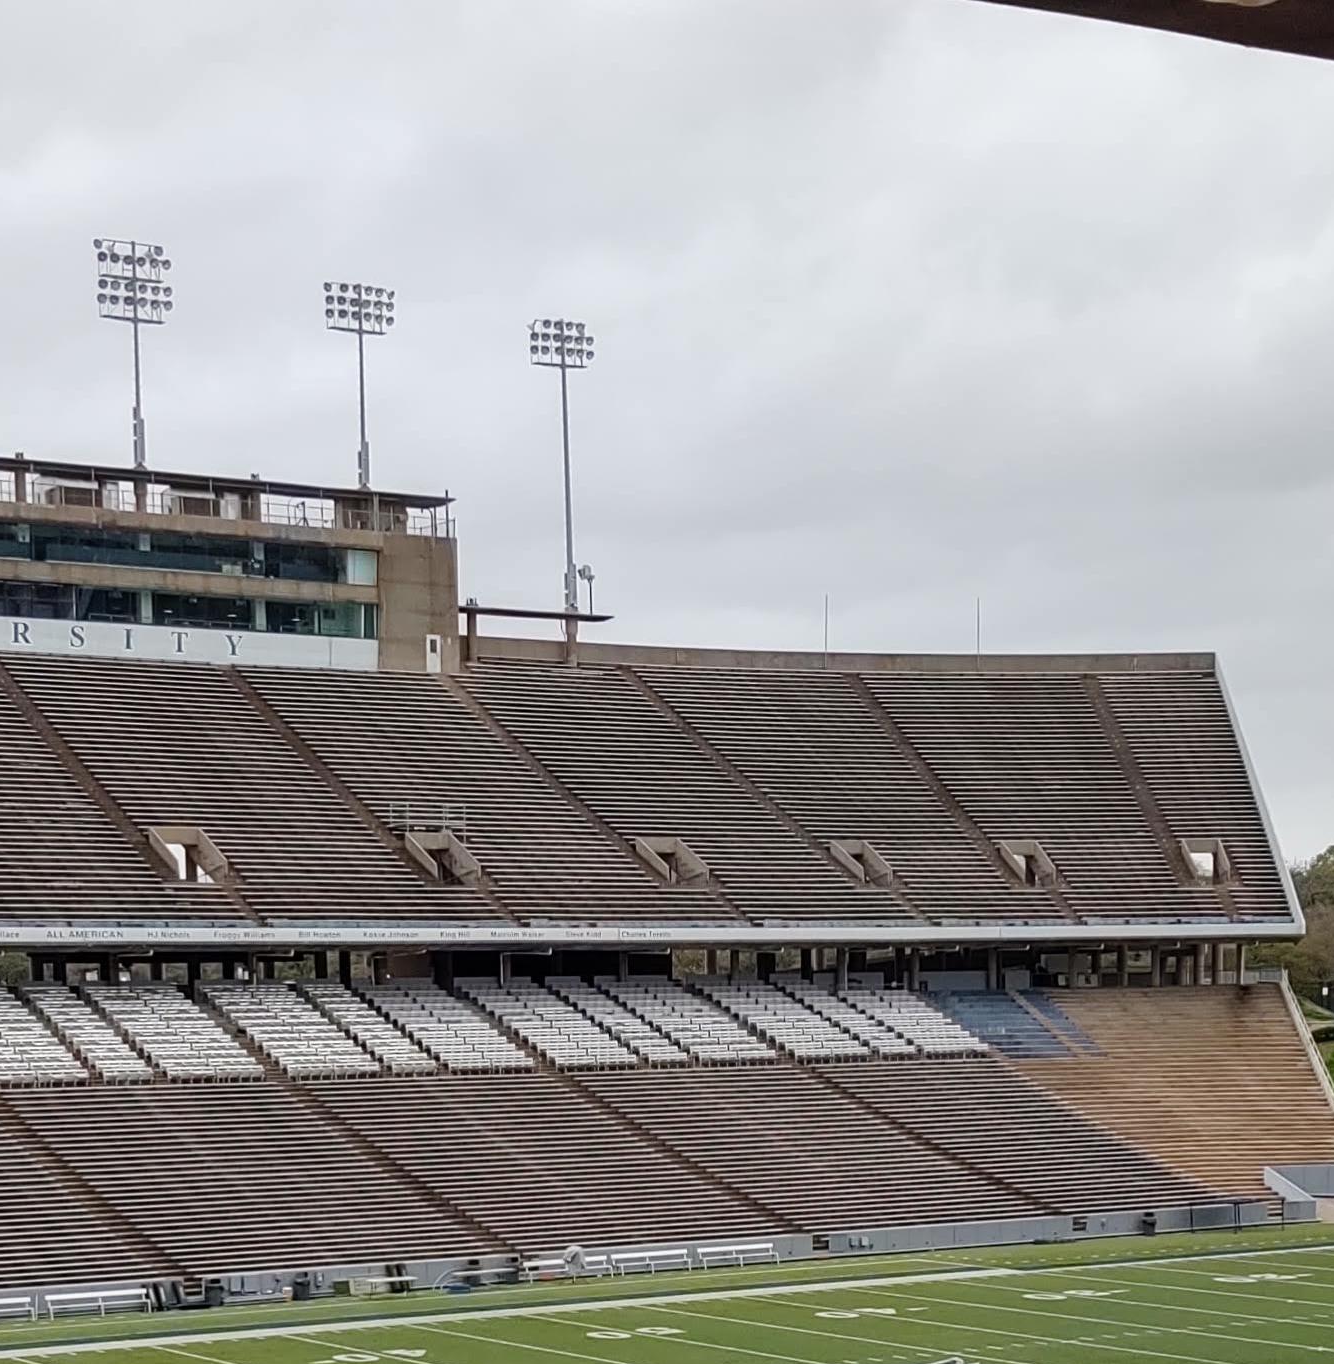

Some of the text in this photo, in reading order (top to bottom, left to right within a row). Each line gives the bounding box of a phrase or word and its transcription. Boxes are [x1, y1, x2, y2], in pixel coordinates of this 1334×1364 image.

[46, 930, 124, 939] ALL AMERICAN
[298, 930, 311, 939] Bill
